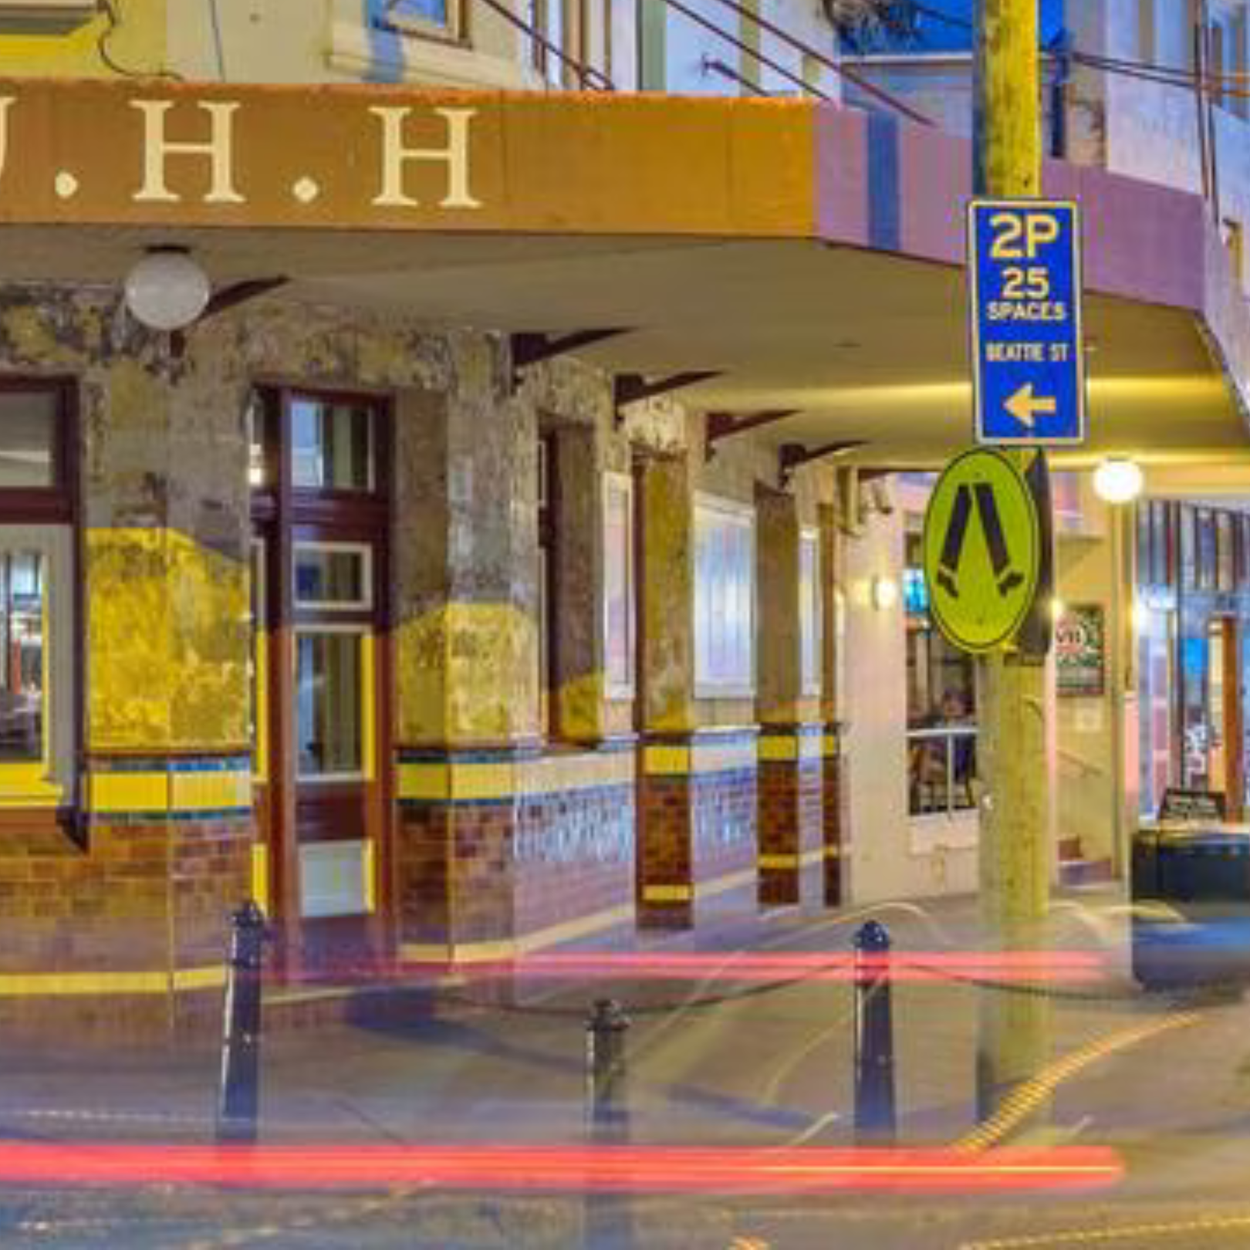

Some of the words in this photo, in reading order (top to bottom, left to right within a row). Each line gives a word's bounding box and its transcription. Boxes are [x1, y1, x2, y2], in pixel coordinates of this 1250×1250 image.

[989, 213, 1058, 258] 2P
[1001, 267, 1049, 300] 25
[986, 301, 1066, 321] SPACES
